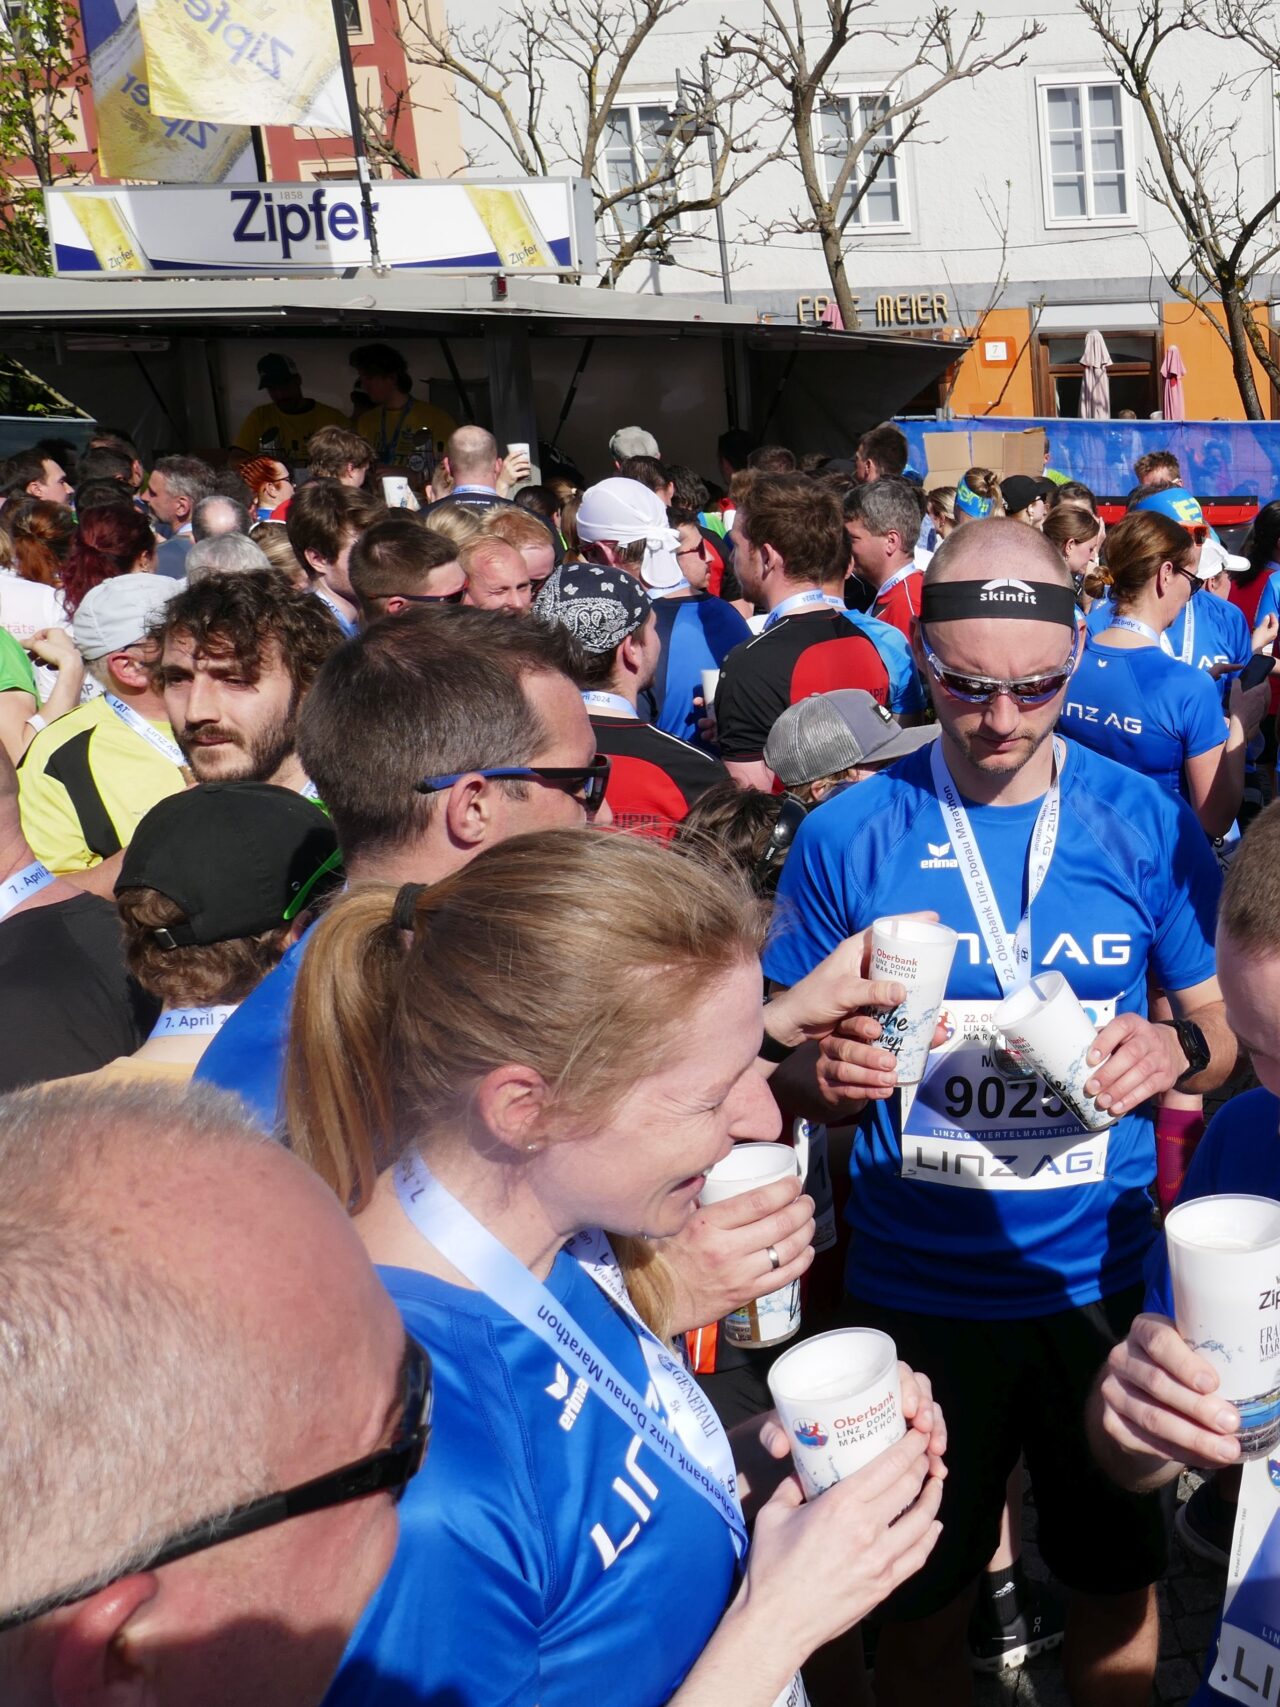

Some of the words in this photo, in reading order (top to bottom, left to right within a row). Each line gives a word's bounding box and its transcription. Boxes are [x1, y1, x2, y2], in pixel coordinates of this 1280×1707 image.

[279, 191, 303, 200] 1858
[230, 188, 379, 259] Zipfer
[508, 244, 538, 265] Zipfer
[877, 293, 949, 321] MEIER
[993, 344, 999, 355] 7
[979, 590, 1037, 604] skinfit
[592, 694, 611, 704] 2024
[1104, 712, 1142, 735] AG
[943, 785, 968, 840] Marathon
[1044, 800, 1058, 832] LINZ
[1042, 835, 1054, 856] AG
[921, 857, 960, 869] erima
[963, 841, 981, 880] Donau
[8, 883, 25, 894] 7.
[24, 868, 46, 888] April
[975, 880, 990, 905] Linz
[982, 905, 1008, 962] Oberbank
[876, 948, 918, 966] Oberbank
[1041, 932, 1132, 965] AG
[875, 965, 916, 980] MARATHON
[890, 962, 917, 973] DONAU
[1000, 962, 1016, 981] 22.
[165, 1016, 175, 1029] 7.
[178, 1012, 214, 1029] April
[963, 1013, 979, 1024] 22.
[963, 1033, 996, 1041] MARA
[976, 1126, 1080, 1139] VIERTELMARATHON
[916, 1146, 1018, 1177] LINZ
[1030, 1151, 1094, 1176] AG
[537, 1304, 603, 1381] Marathon
[558, 1376, 590, 1432] erima
[605, 1376, 647, 1429] Donau
[668, 1399, 681, 1416] 5k
[672, 1369, 719, 1439] GENERALI
[833, 1391, 895, 1431] Oberbank
[836, 1424, 862, 1440] LINZ
[865, 1401, 897, 1429] DONAU
[837, 1411, 899, 1448] MARATHON
[649, 1425, 675, 1455] Linz
[677, 1452, 736, 1521] Oberbank
[590, 1432, 661, 1571] LIN
